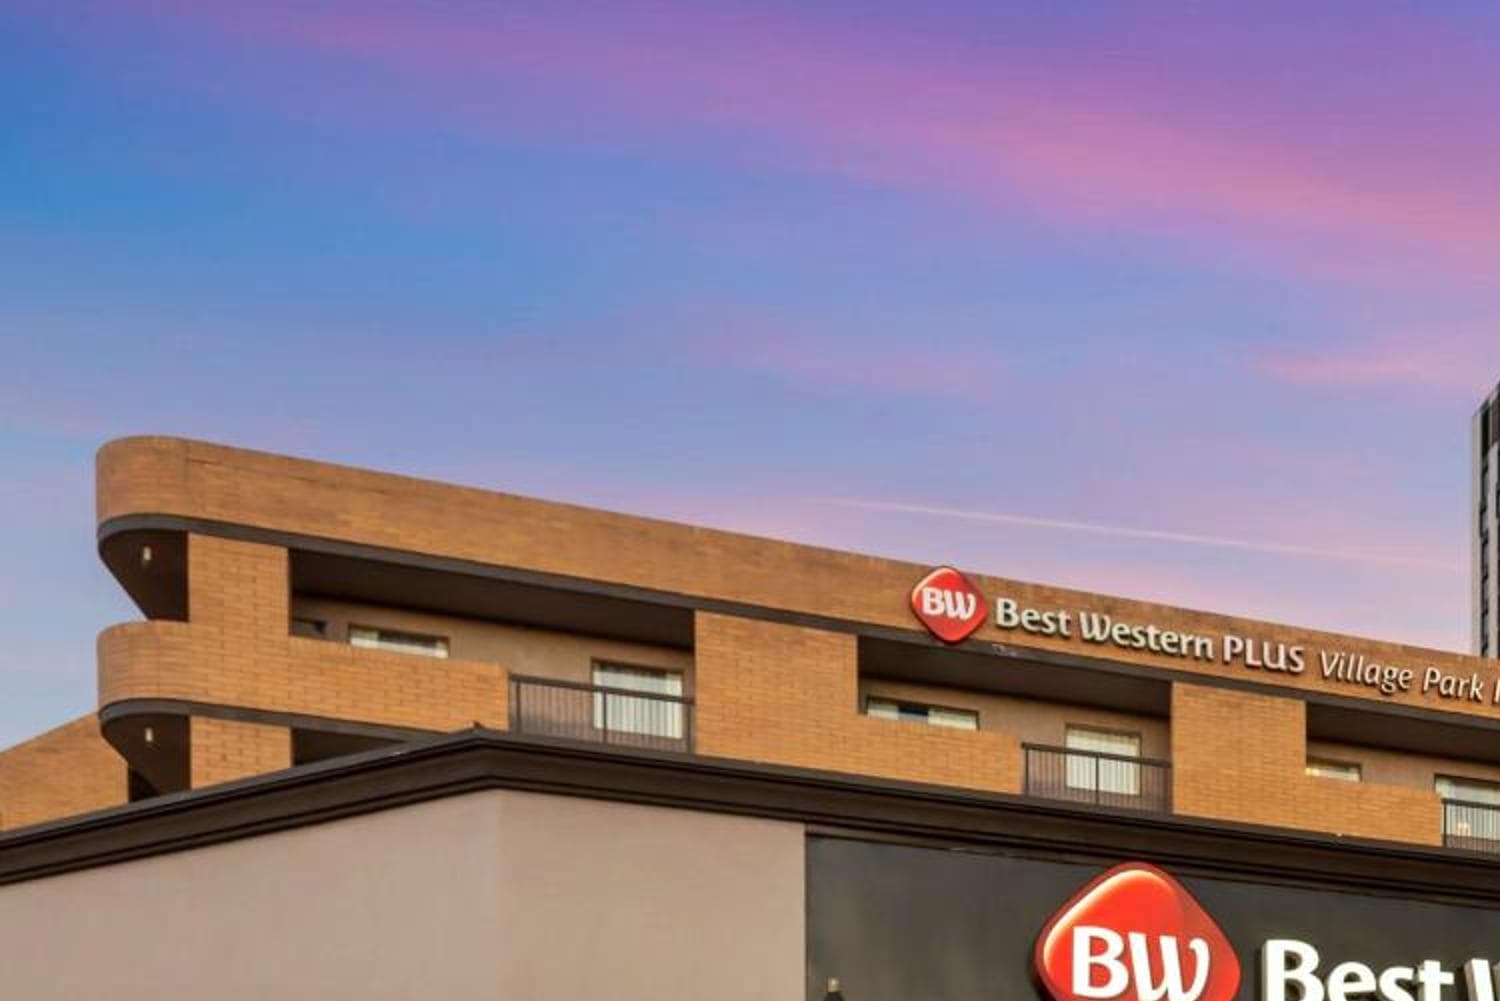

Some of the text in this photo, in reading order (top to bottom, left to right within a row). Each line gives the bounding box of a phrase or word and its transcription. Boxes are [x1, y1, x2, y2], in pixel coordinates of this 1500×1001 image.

[921, 586, 977, 622] BW
[996, 597, 1071, 636] Best
[1080, 611, 1215, 660] Western
[1222, 635, 1306, 673] PLUS
[1319, 649, 1413, 695] Village
[1423, 666, 1484, 702] Park
